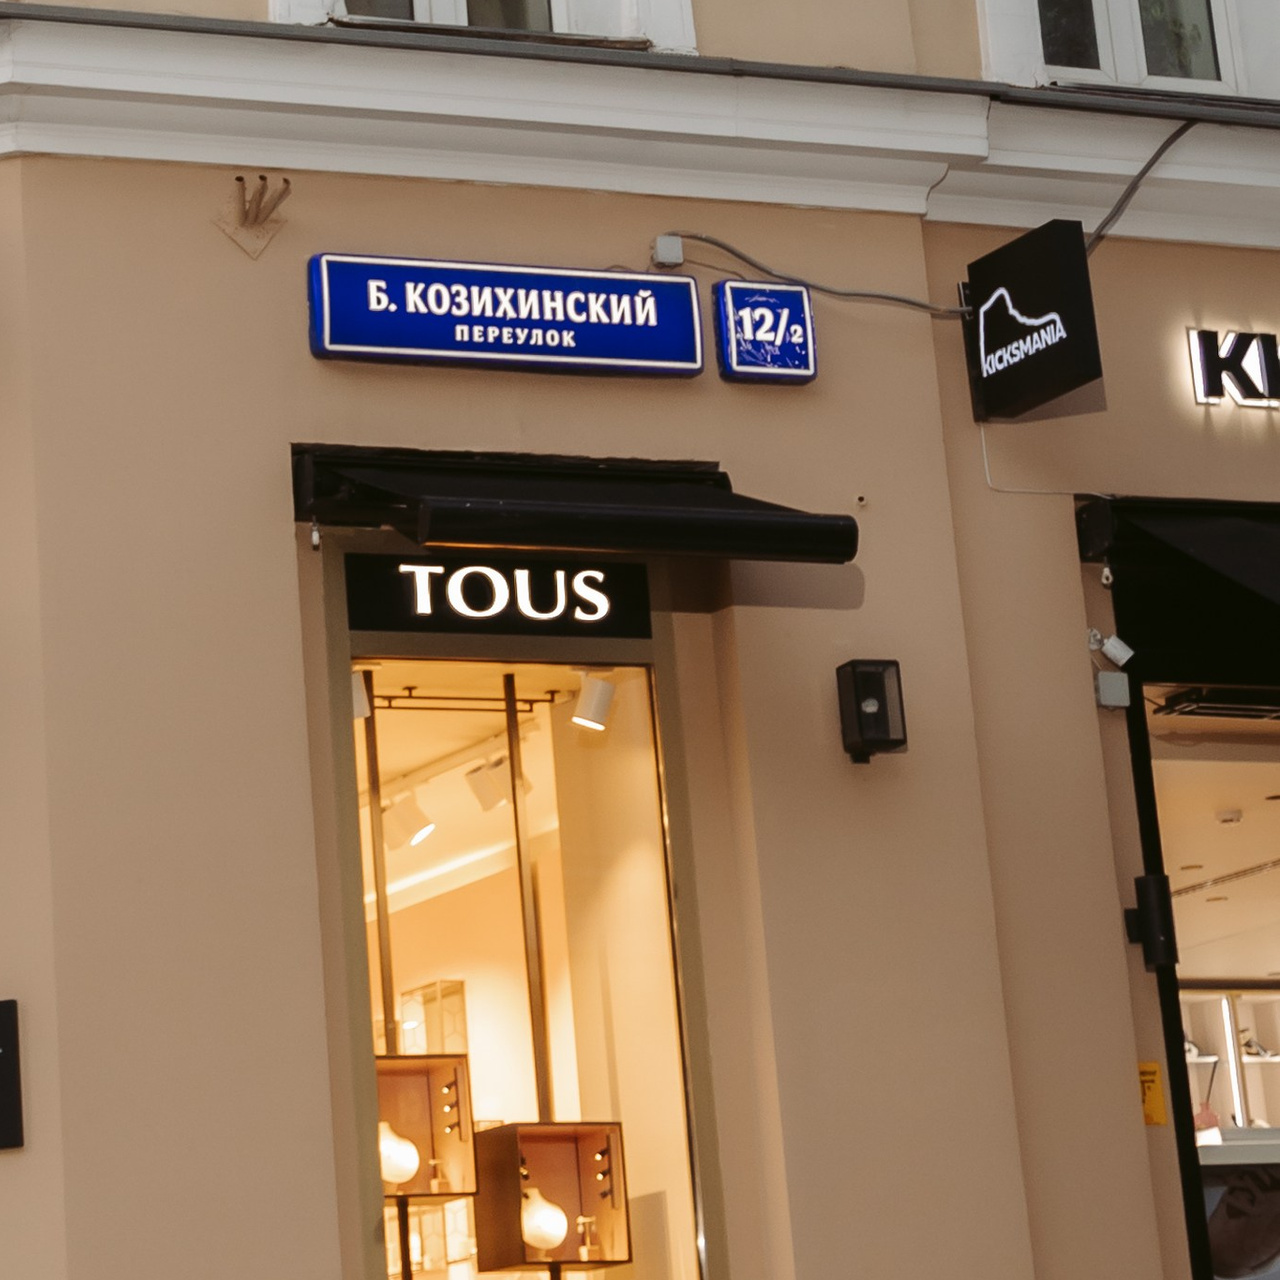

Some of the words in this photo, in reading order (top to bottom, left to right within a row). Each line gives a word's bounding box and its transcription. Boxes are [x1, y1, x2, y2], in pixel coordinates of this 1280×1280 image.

[367, 279, 398, 313] Б.
[405, 281, 658, 327] КОЗИХИНСКИЙ
[738, 306, 804, 347] 12/2
[455, 324, 576, 348] ПЕРЕУЛОК
[982, 323, 1068, 378] KICKSMANIA
[398, 563, 611, 622] TOUS
